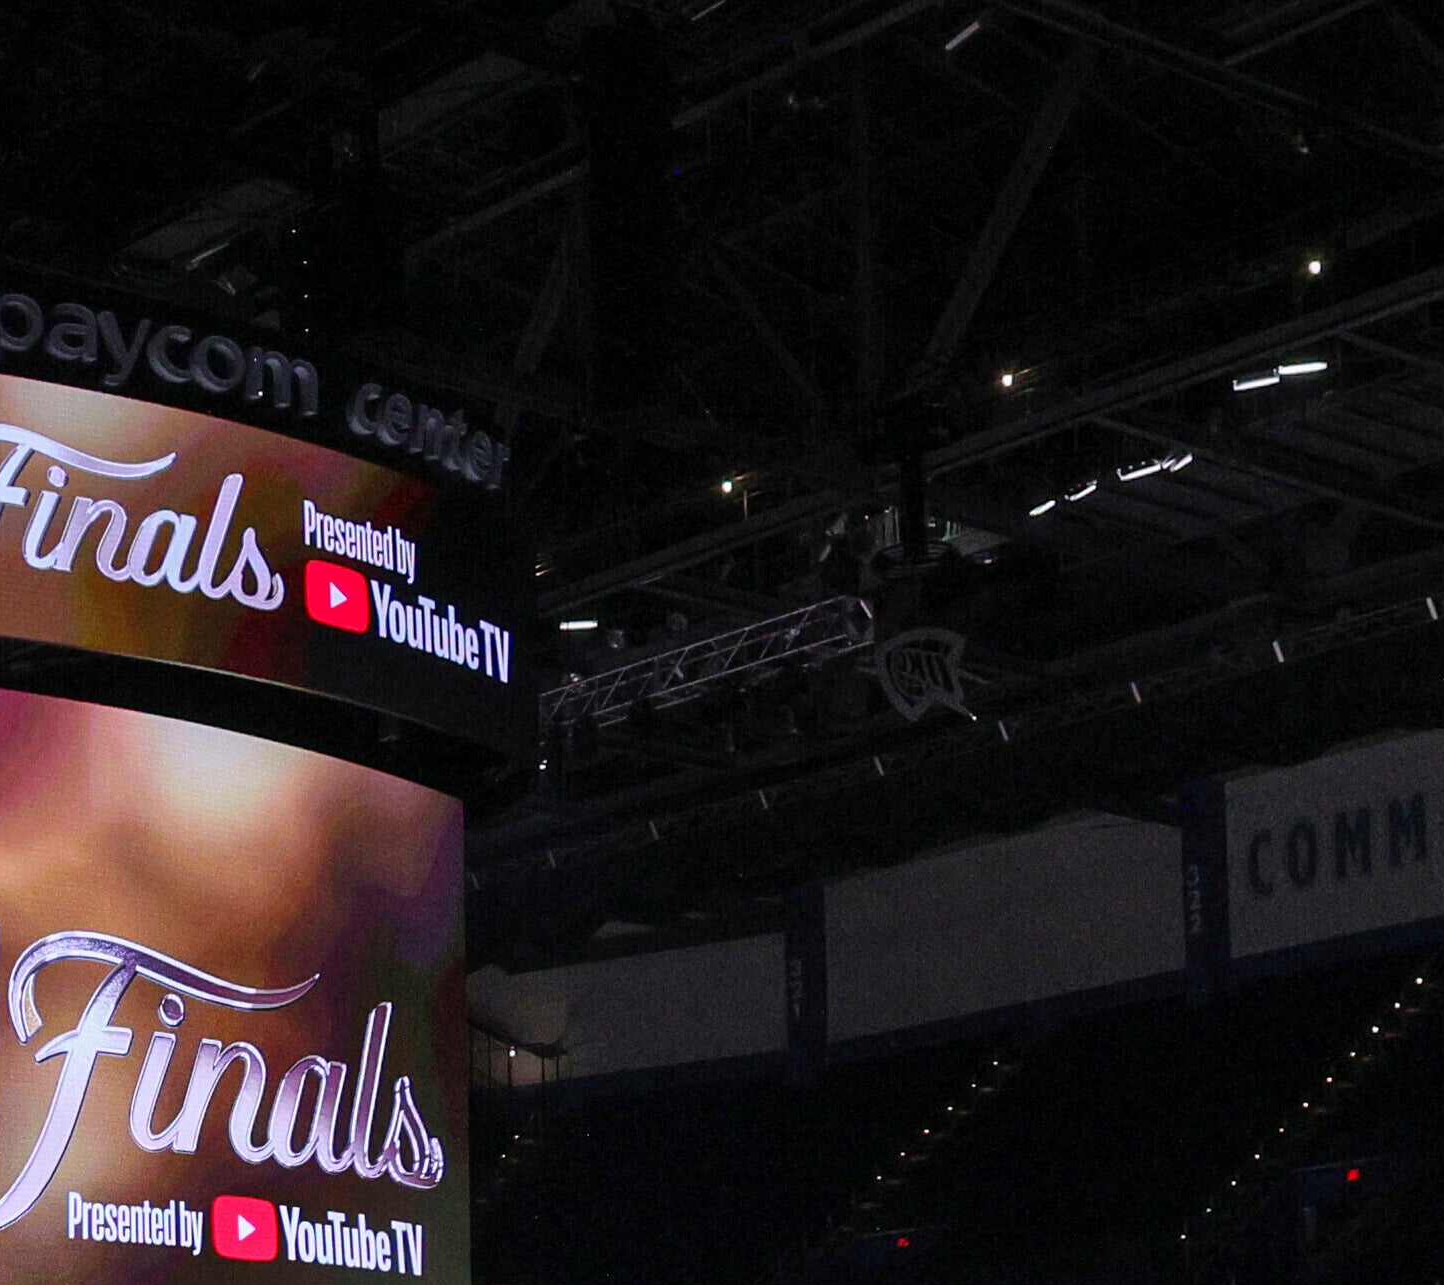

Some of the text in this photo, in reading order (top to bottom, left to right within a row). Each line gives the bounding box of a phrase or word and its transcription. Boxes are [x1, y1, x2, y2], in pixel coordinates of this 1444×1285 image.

[346, 381, 512, 490] center
[303, 500, 417, 583] Presented by
[370, 580, 511, 685] YouTube TV
[67, 1190, 204, 1257] Presented by
[279, 1204, 426, 1277] YouTube TV
